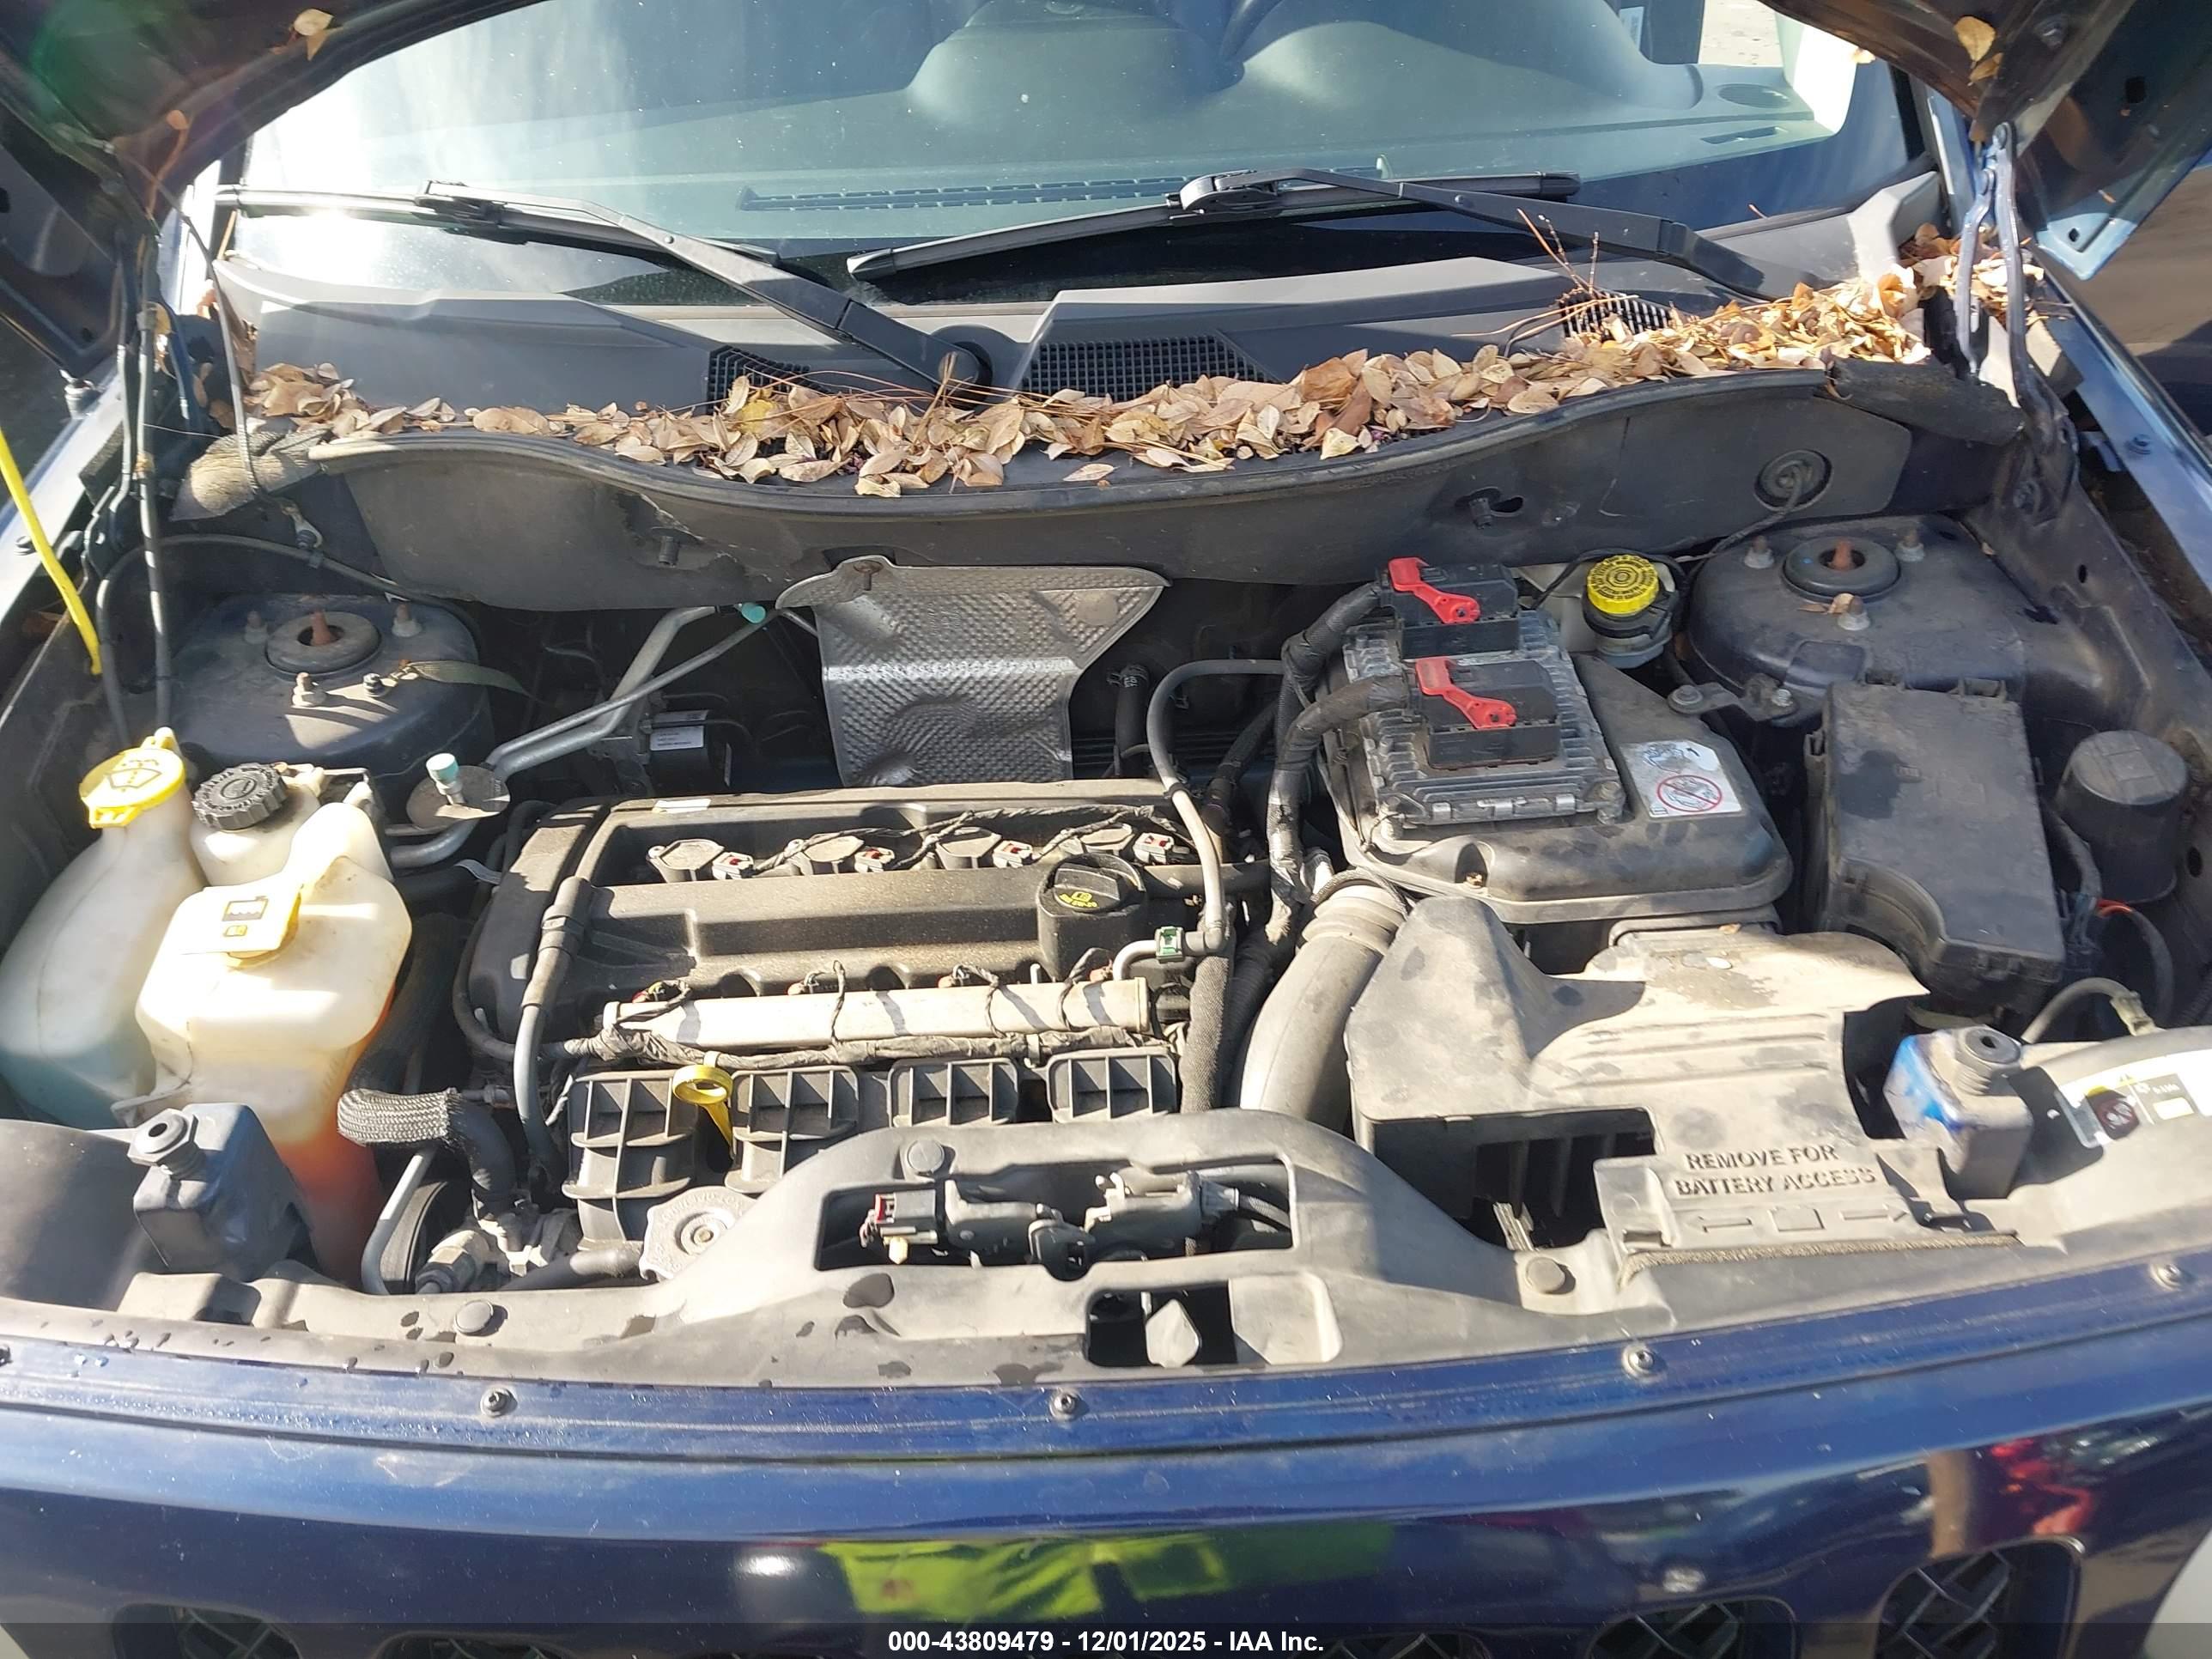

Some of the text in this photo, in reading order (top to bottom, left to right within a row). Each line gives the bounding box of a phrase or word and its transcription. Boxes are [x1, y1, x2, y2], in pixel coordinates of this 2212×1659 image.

[1685, 1144, 1839, 1170] REMOVE FOR
[1674, 1167, 1877, 1197] BATTERY ACCESS
